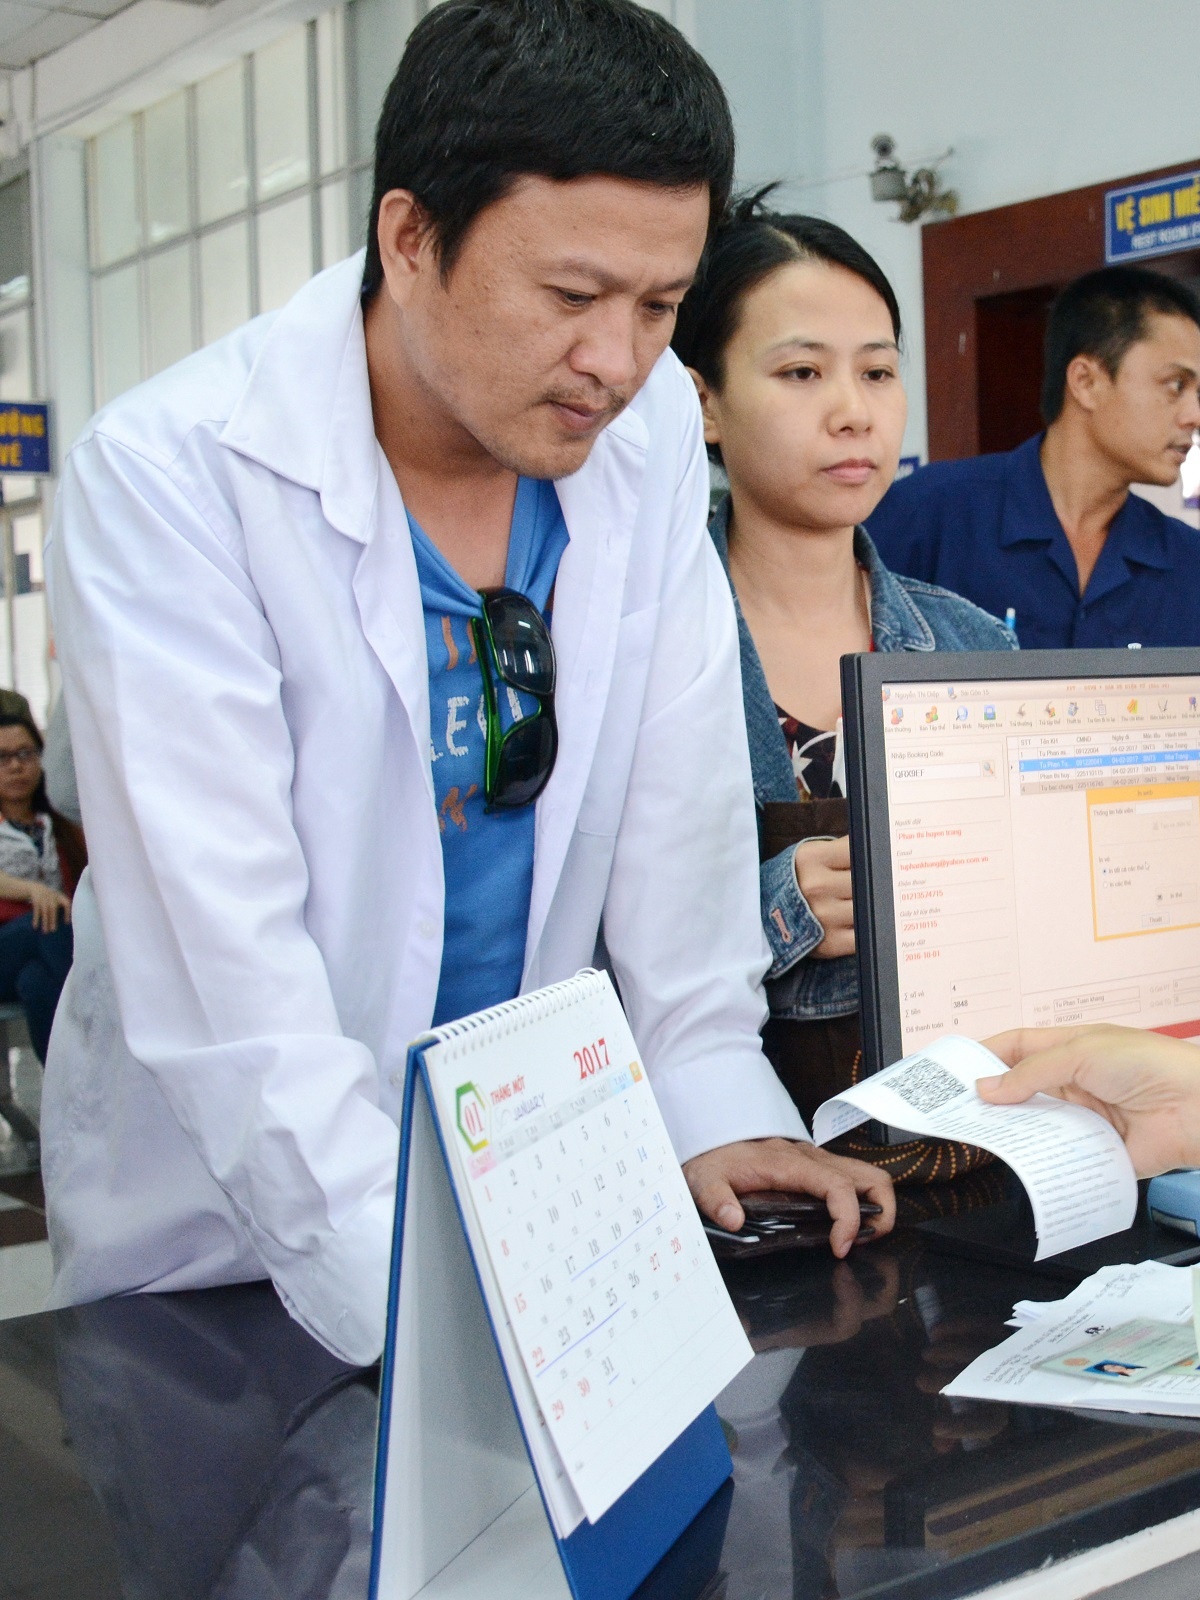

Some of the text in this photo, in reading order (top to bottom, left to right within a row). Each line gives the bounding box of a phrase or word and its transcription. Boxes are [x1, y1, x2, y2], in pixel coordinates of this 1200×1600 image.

[1138, 191, 1172, 227] SINH
[1131, 231, 1158, 250] REST
[1158, 225, 1190, 244] ROOM
[907, 750, 929, 759] Booking
[929, 749, 944, 757] Code
[898, 832, 915, 841] Phan
[573, 1037, 611, 1080] 2017
[463, 1101, 485, 1137] 01
[509, 1168, 518, 1186] 2
[534, 1154, 543, 1171] 3
[558, 1139, 567, 1155] 4
[580, 1124, 590, 1142] 5
[603, 1111, 612, 1128] 6
[623, 1098, 632, 1115] 7
[501, 1144, 649, 1257] 8 9 10 11 12 13 14
[513, 1191, 665, 1314] 15 16 17 18 19 20 21
[531, 1236, 683, 1369] 22 23 24 25 26 27 28
[551, 1355, 615, 1421] 29 30 31
